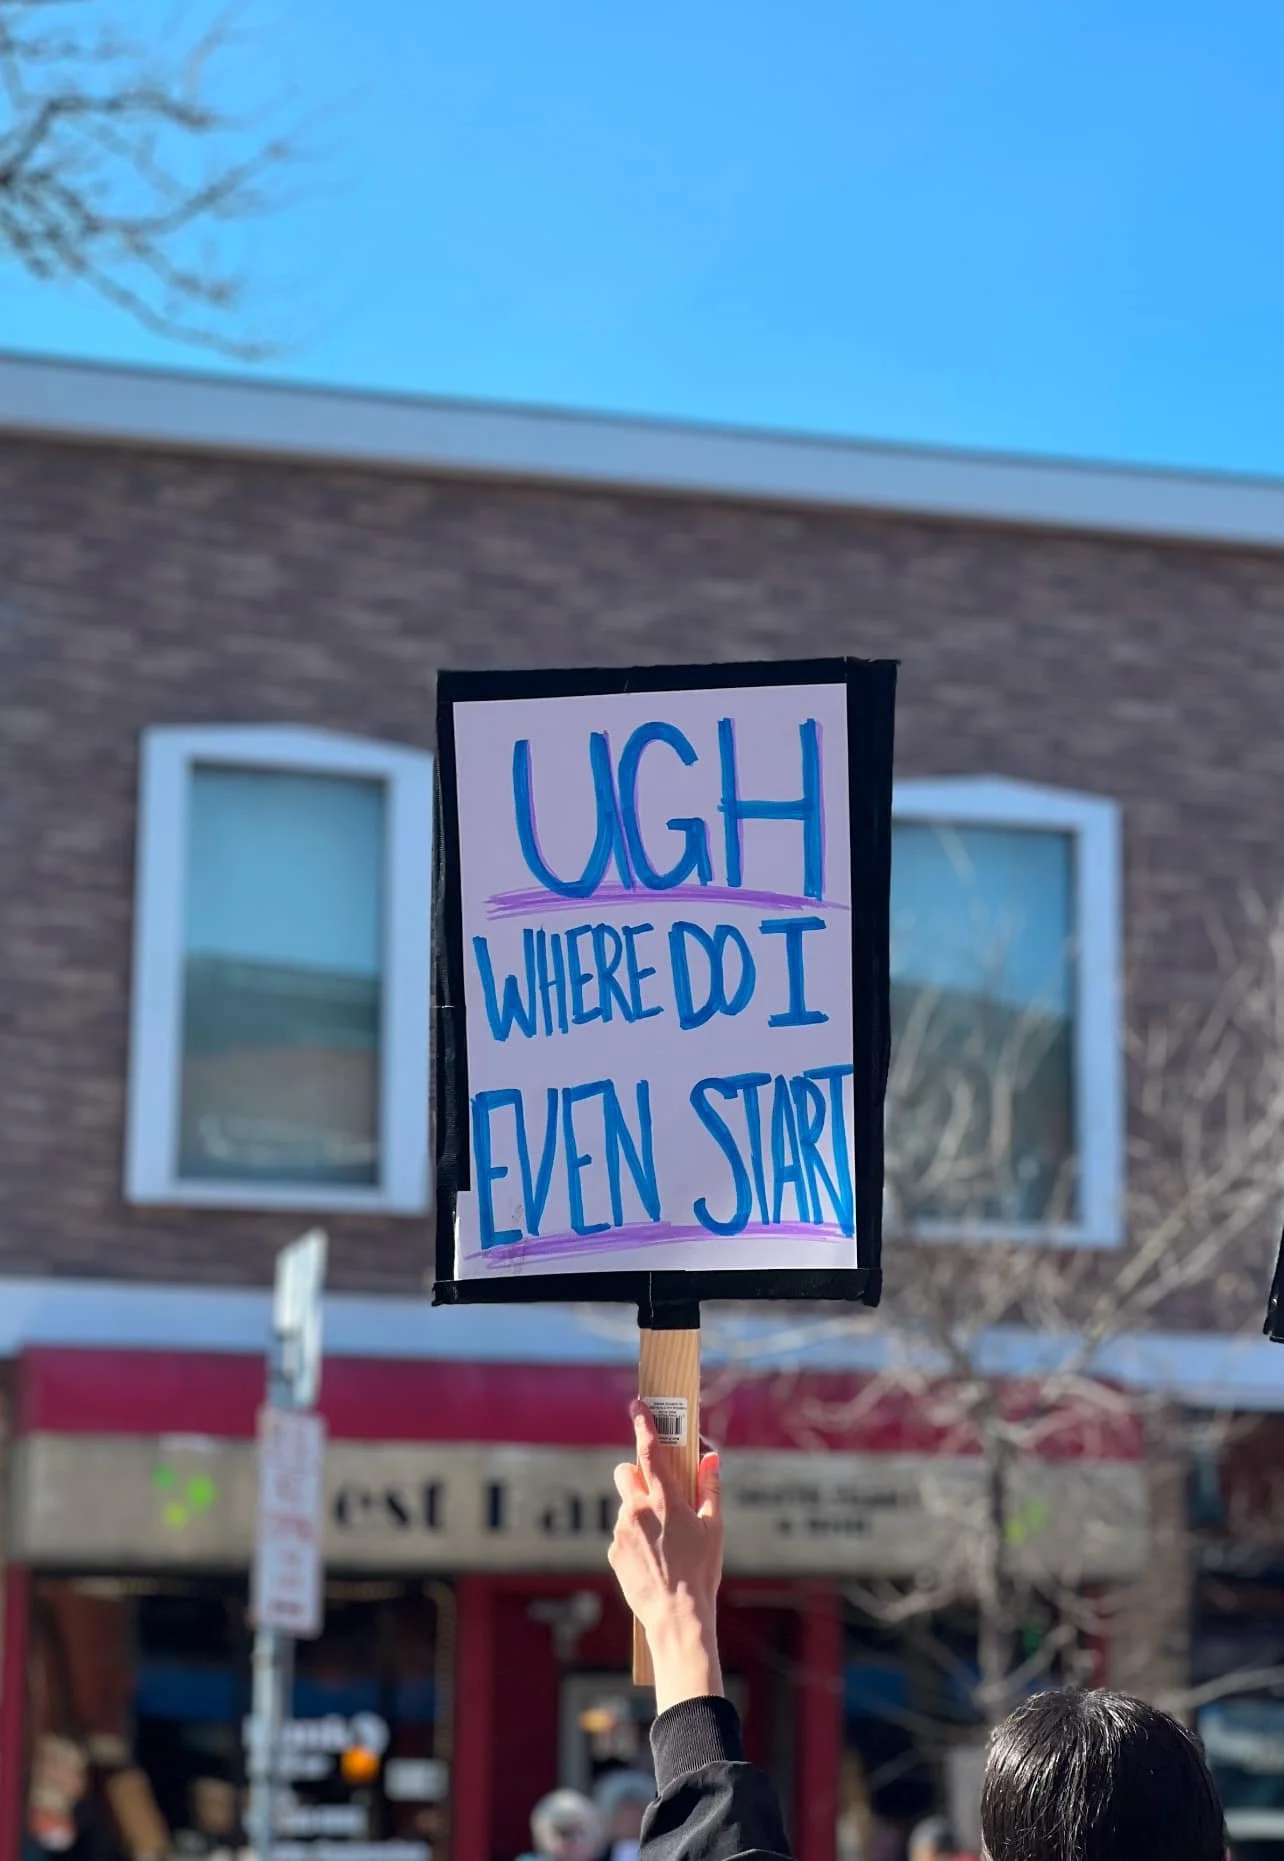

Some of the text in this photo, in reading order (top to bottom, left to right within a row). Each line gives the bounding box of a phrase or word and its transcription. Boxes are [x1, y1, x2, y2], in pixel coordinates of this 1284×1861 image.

[513, 716, 824, 901] UGH
[473, 915, 828, 1041] WHERE DO I
[471, 1063, 855, 1250] EVEN START
